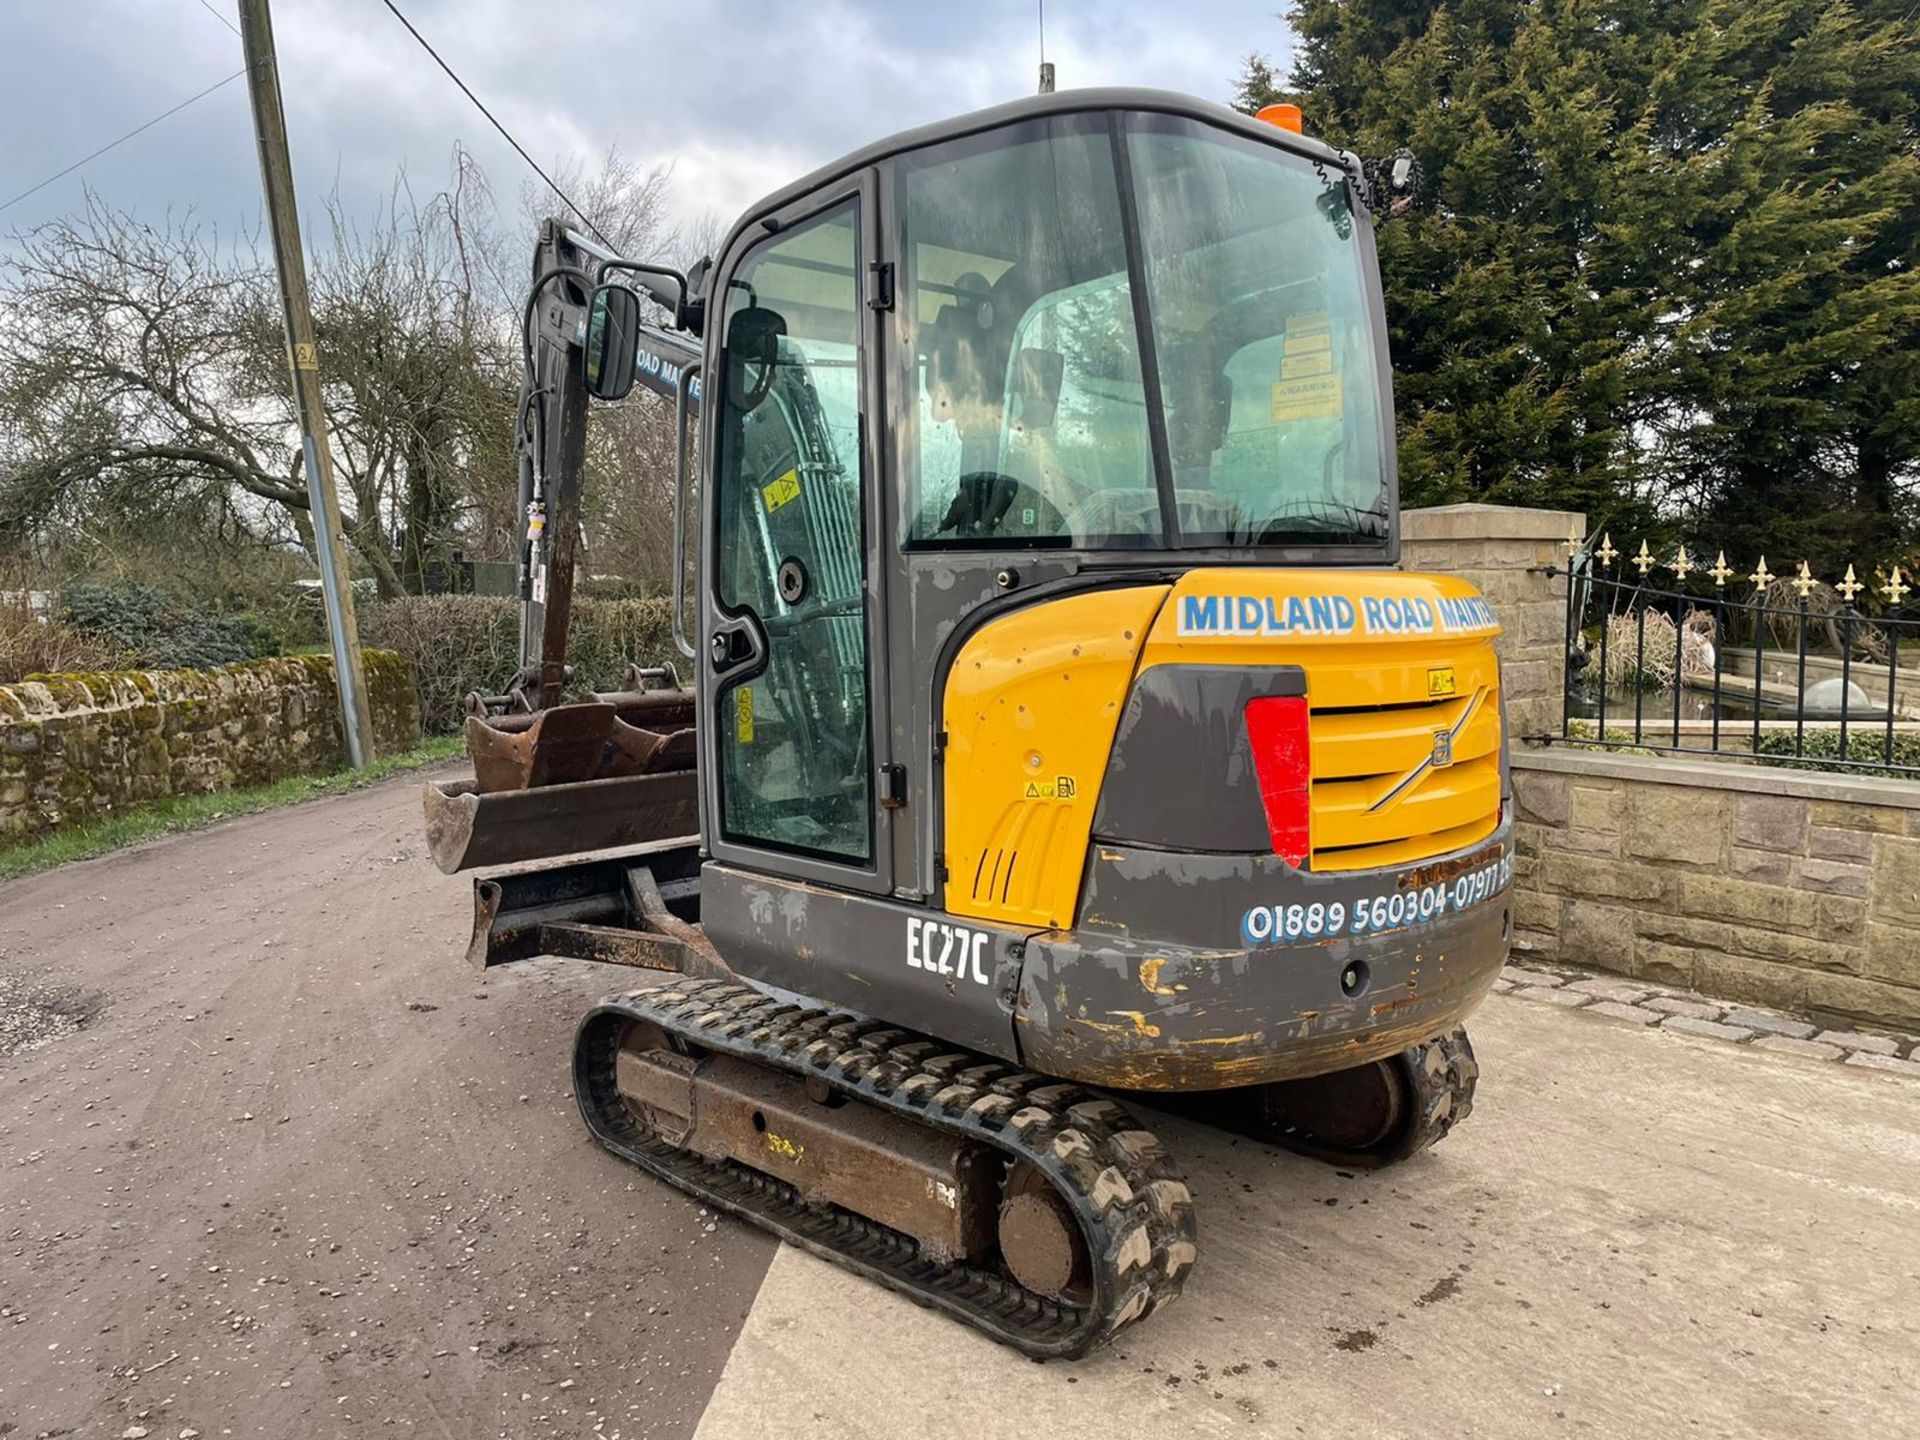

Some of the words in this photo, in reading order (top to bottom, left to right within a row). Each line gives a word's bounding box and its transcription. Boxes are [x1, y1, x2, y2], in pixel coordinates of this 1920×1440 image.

[636, 348, 660, 375] OAD
[1285, 380, 1335, 395] WARNING
[1178, 595, 1355, 636] MIDLAND
[1361, 597, 1435, 636] ROAD
[1242, 902, 1345, 943] 01889
[1350, 864, 1498, 933] 560304-07977
[906, 917, 990, 986] EC27C
